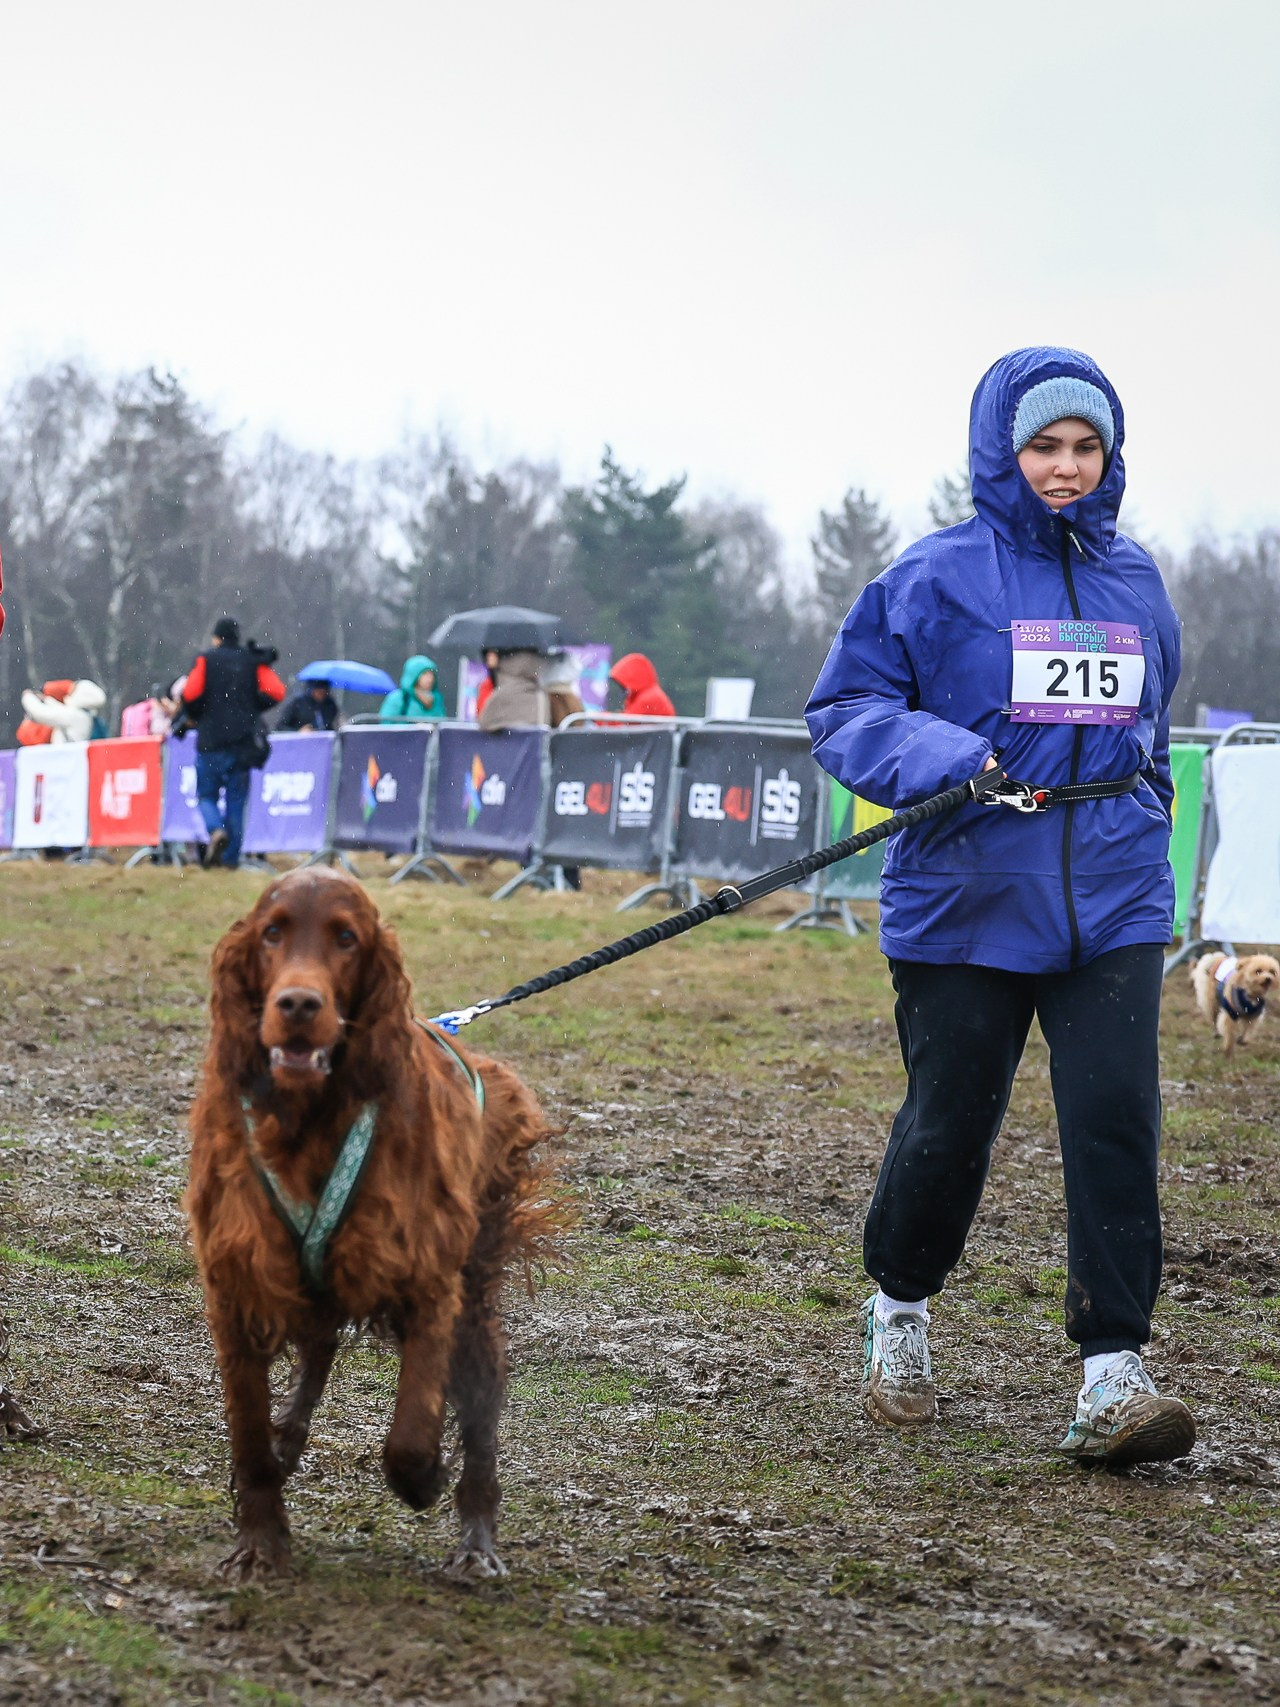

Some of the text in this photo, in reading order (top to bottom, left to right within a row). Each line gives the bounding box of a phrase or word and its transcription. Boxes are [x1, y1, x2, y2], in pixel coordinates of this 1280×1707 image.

[1019, 625, 1051, 633] 11/04
[1020, 633, 1051, 642] 2026
[1058, 631, 1107, 643] БЫСТРЫЙ
[1114, 635, 1121, 644] 2
[1046, 658, 1119, 698] 215
[554, 781, 612, 815] GEL4U
[688, 782, 752, 822] GEL4U
